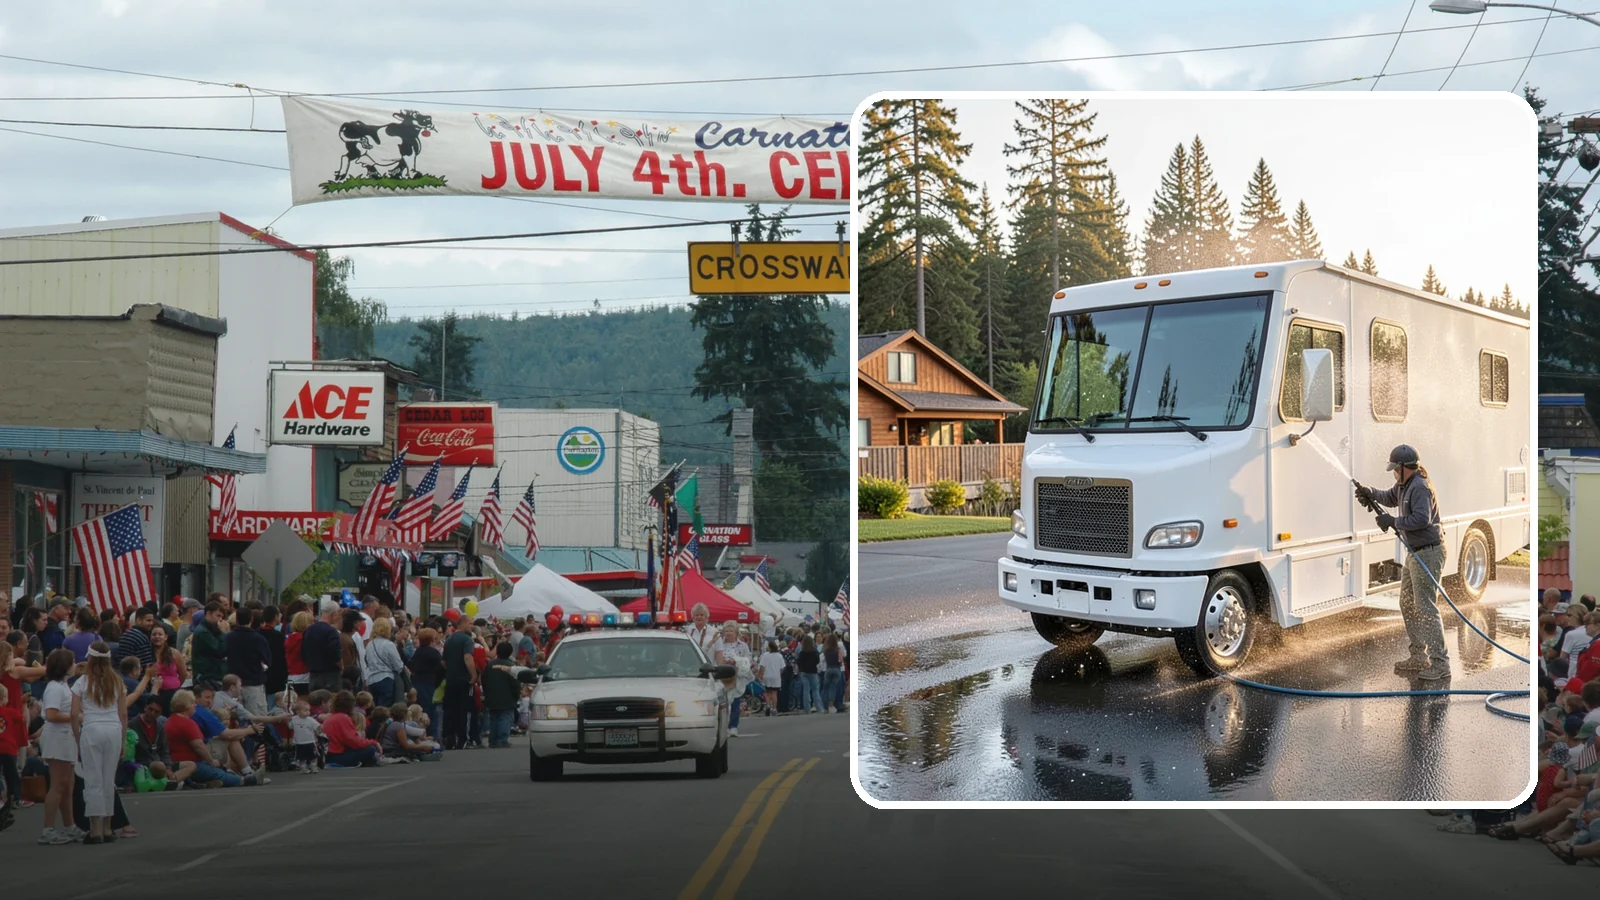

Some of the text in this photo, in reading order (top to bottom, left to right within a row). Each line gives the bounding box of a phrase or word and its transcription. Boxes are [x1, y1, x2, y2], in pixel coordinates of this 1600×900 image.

[695, 121, 850, 149] Carnat
[481, 141, 605, 193] JULY
[632, 149, 746, 198] 4th.
[697, 254, 850, 280] CROSSWA
[282, 379, 374, 420] ACE
[406, 409, 485, 422] CEDAR LOG
[283, 420, 371, 437] Hardware
[416, 428, 477, 447] Coca-Cola
[353, 467, 385, 481] Simpl
[96, 484, 124, 495] Vincent
[126, 486, 136, 495] de
[137, 485, 155, 495] Paul
[81, 503, 153, 522] THT
[212, 515, 331, 535] HARDARE
[688, 526, 741, 535] CRNATION
[699, 535, 730, 544] GLASS
